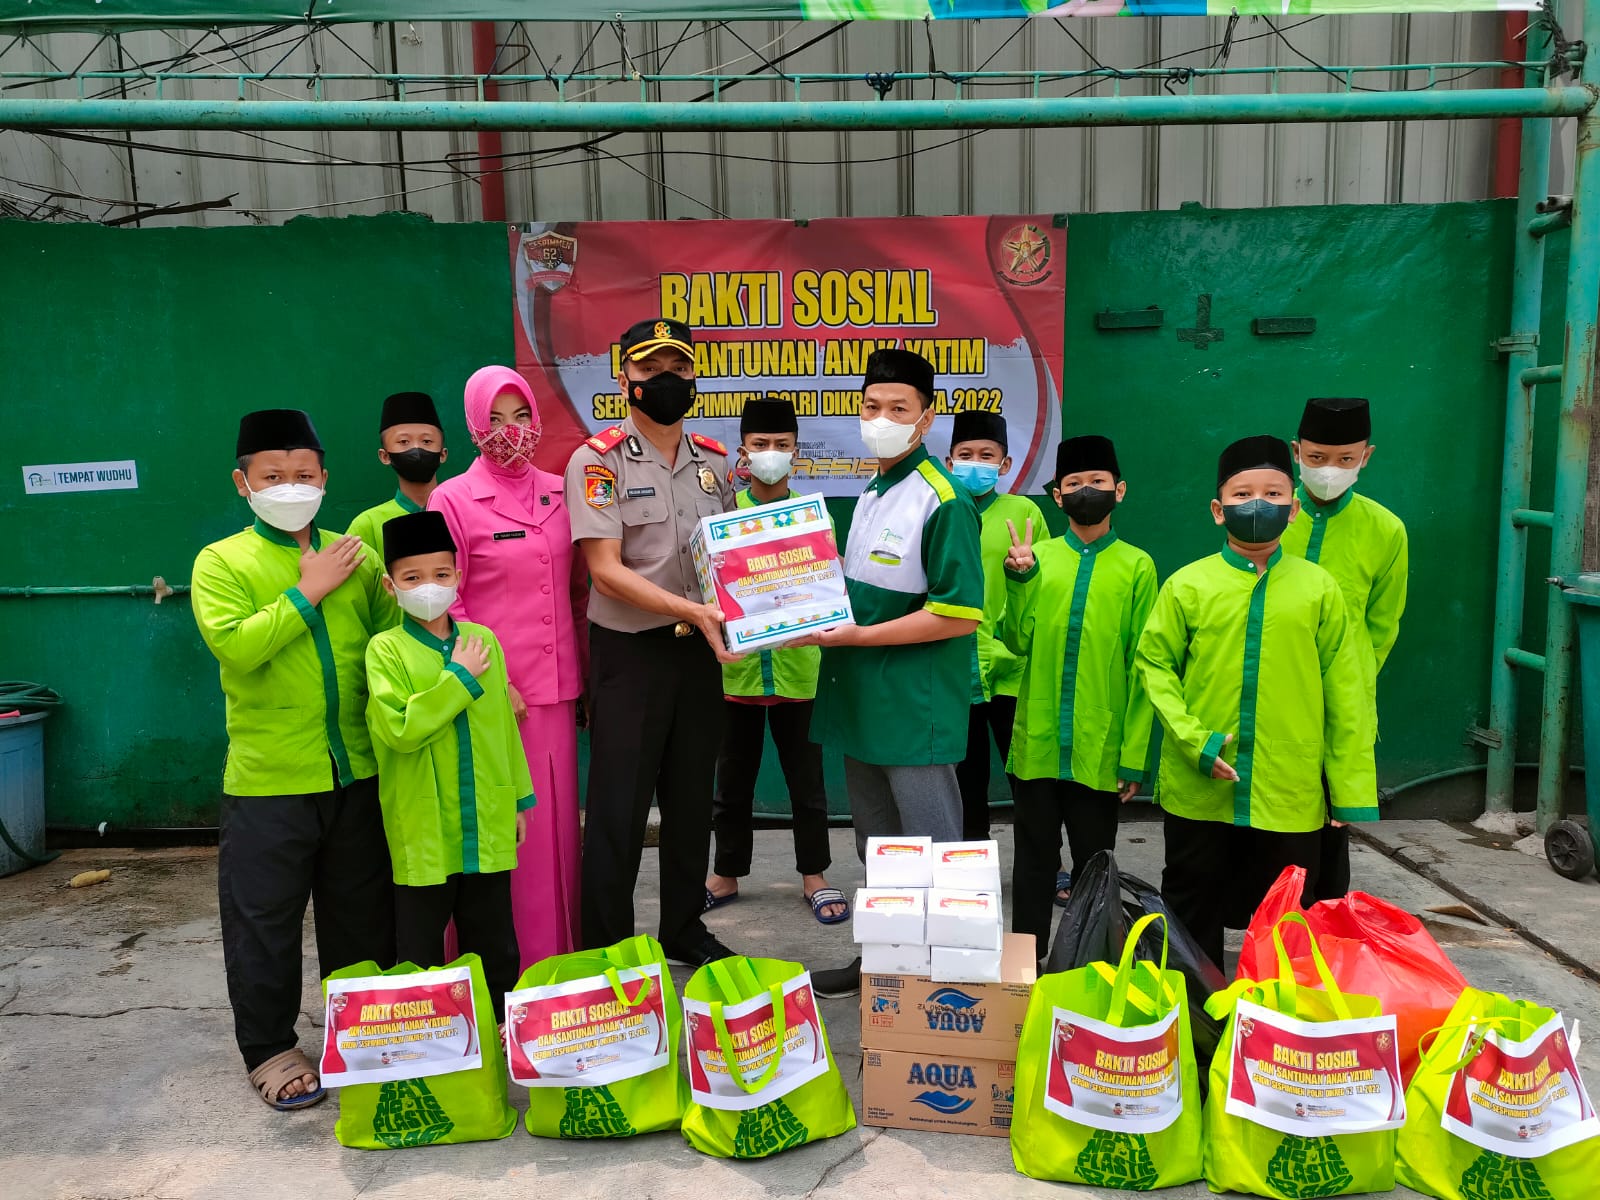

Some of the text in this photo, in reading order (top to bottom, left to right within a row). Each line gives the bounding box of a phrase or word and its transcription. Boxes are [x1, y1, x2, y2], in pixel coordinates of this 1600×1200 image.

[543, 248, 558, 260] 62
[659, 268, 937, 328] BAKTI SOSIAL
[692, 339, 818, 379] ANTUNAN
[823, 340, 898, 376] ANA
[932, 387, 1003, 416] A.2022
[57, 470, 95, 484] TEMPAT
[96, 468, 132, 482] WUDHU
[790, 456, 880, 475] RESIS
[746, 545, 816, 572] BAKTI SOSIAL
[360, 999, 436, 1022] BAKTI SOSIAL
[551, 1000, 630, 1030] BAKTI SOSIAL
[926, 1007, 986, 1034] AQUA
[361, 1022, 402, 1036] SANTUNAN
[404, 1019, 425, 1031] ANAK
[426, 1015, 452, 1028] YATIM
[537, 1013, 644, 1047] DAN SANTUNAN ANAK YATIM
[749, 1017, 775, 1044] SOSI
[1095, 1049, 1136, 1073] BAKTI
[1273, 1043, 1360, 1071] BAKTI SOSIAL
[907, 1062, 977, 1091] AQUA
[1078, 1063, 1097, 1079] DAN
[1098, 1071, 1144, 1086] SANTUNAN
[1258, 1060, 1375, 1085] DAN SANTUNAN ANAK YATIM
[1497, 1067, 1535, 1091] BAKTI
[379, 1077, 432, 1102] SAY
[564, 1085, 616, 1108] SAY
[1479, 1080, 1497, 1099] DAN
[373, 1109, 451, 1132] PLASTIC
[559, 1116, 632, 1136] PLASTIC
[735, 1116, 804, 1156] PLASTIC
[1077, 1151, 1157, 1180] PLASTIC
[1268, 1160, 1349, 1184] PLASTIC
